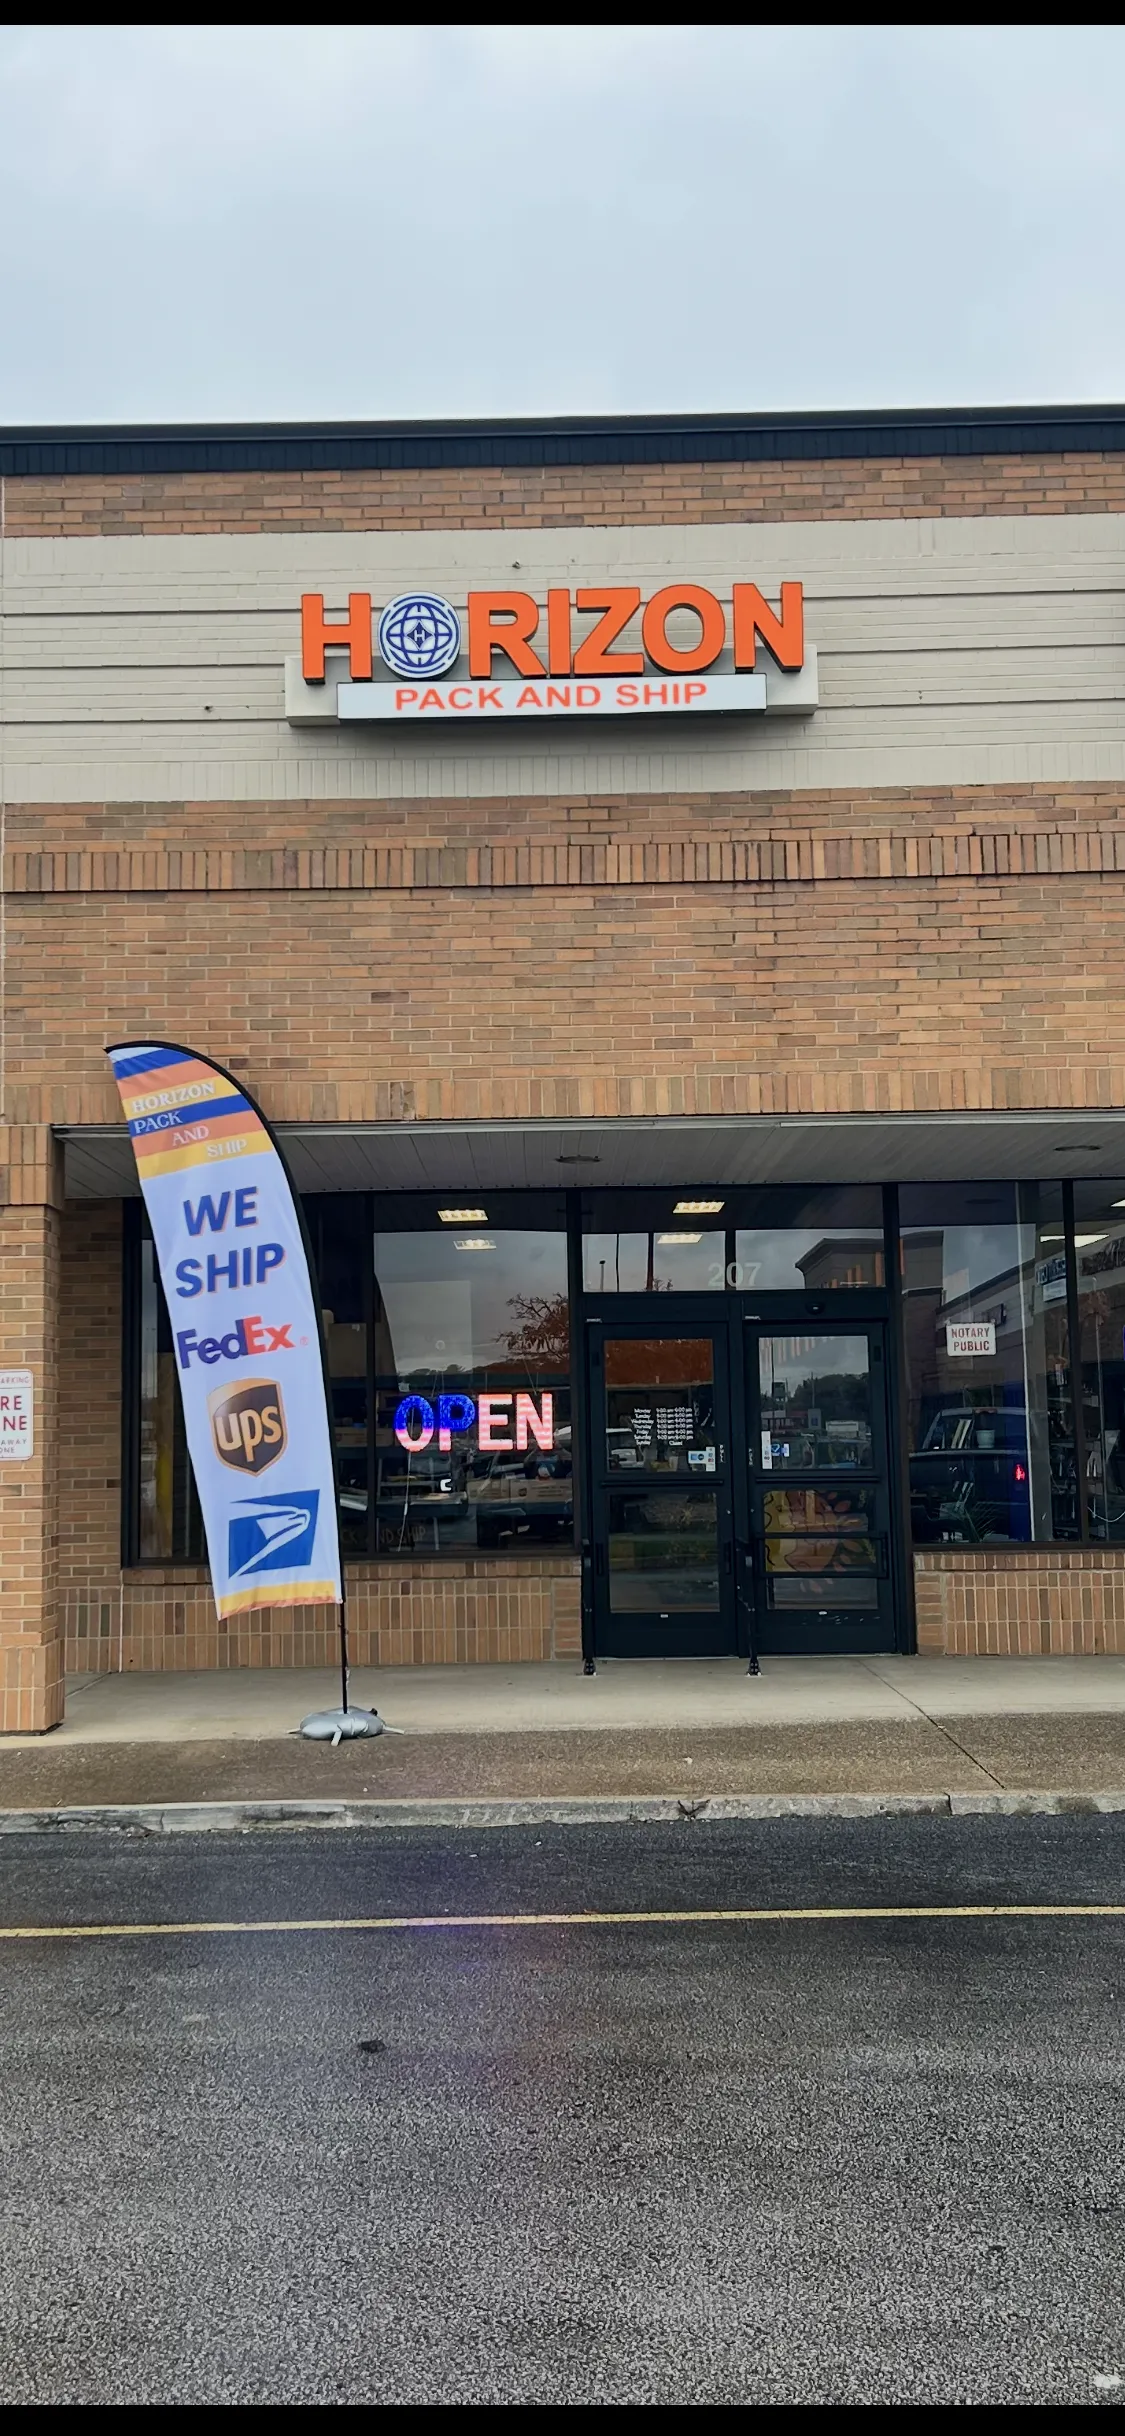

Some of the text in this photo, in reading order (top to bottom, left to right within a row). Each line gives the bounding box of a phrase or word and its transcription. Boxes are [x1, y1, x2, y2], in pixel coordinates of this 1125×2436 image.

[301, 582, 803, 683] HORIZON
[395, 682, 707, 711] PACK AND SHIP
[132, 1081, 216, 1113] HORIZON
[133, 1110, 184, 1134] PACK
[172, 1124, 210, 1147] AND
[207, 1138, 248, 1158] SHIP
[183, 1186, 259, 1237] WE
[175, 1242, 287, 1299] SHIP
[707, 1261, 763, 1288] 207
[176, 1315, 296, 1369] FedEx
[951, 1326, 990, 1339] NOTARY
[953, 1340, 990, 1352] PUBLIC
[0, 1375, 30, 1384] ARKING
[0, 1395, 23, 1411] RE
[3, 1415, 28, 1432] NE
[215, 1405, 282, 1463] ups
[394, 1392, 554, 1452] OPEN
[0, 1438, 27, 1446] AWAY
[0, 1446, 15, 1454] ONE
